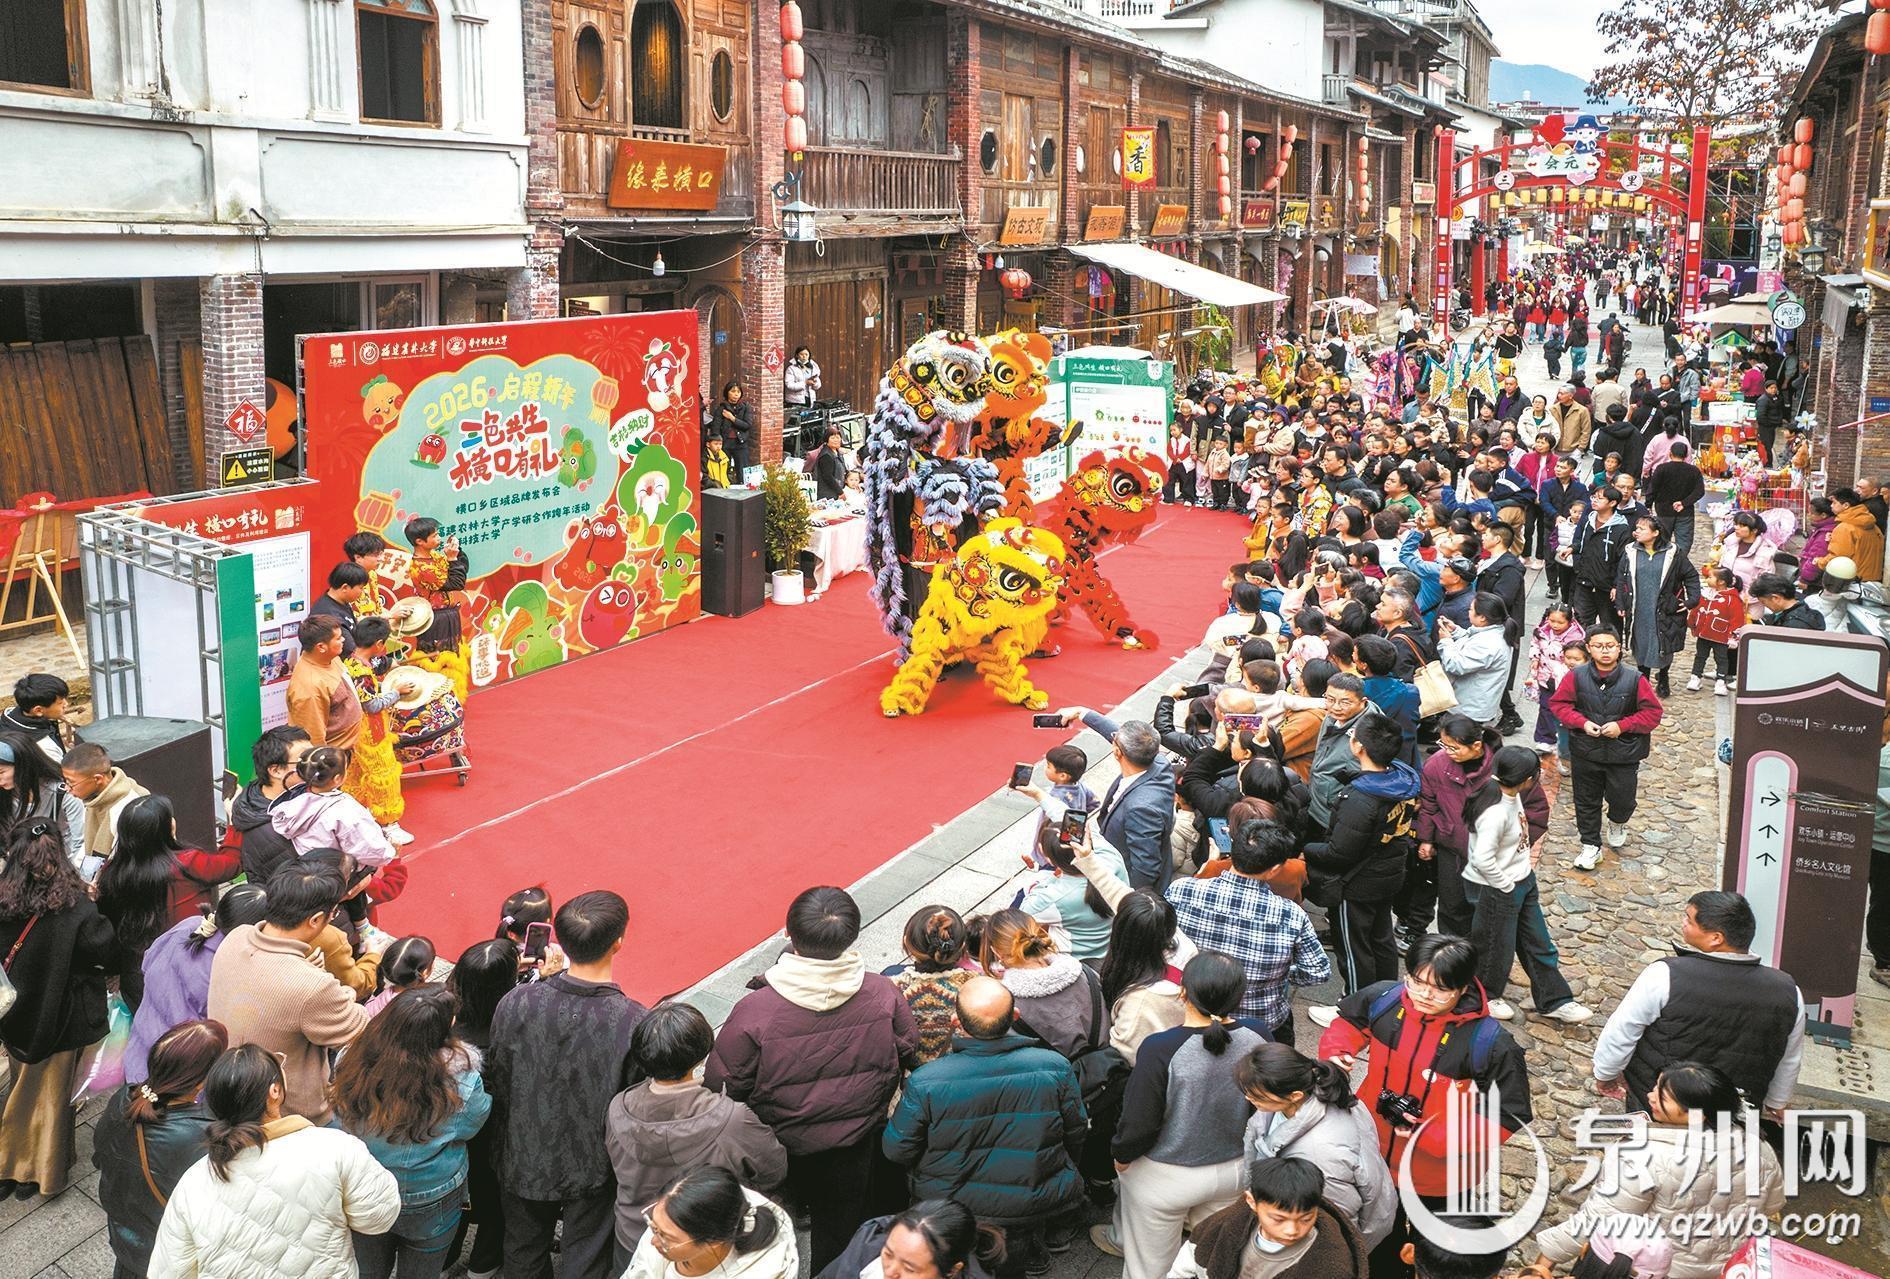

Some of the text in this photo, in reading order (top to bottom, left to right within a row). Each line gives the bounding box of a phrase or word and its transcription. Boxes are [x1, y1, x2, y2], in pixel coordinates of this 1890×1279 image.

[1130, 144, 1148, 174] 香
[1626, 174, 1638, 187] 里
[234, 408, 258, 434] 福
[461, 403, 548, 447] 三色共生
[449, 437, 560, 490] 横口有礼
[455, 485, 561, 515] 横口乡区域品牌发布会
[1800, 805, 1857, 818] Comfort Station
[1795, 857, 1852, 874] 侨乡名人文化馆
